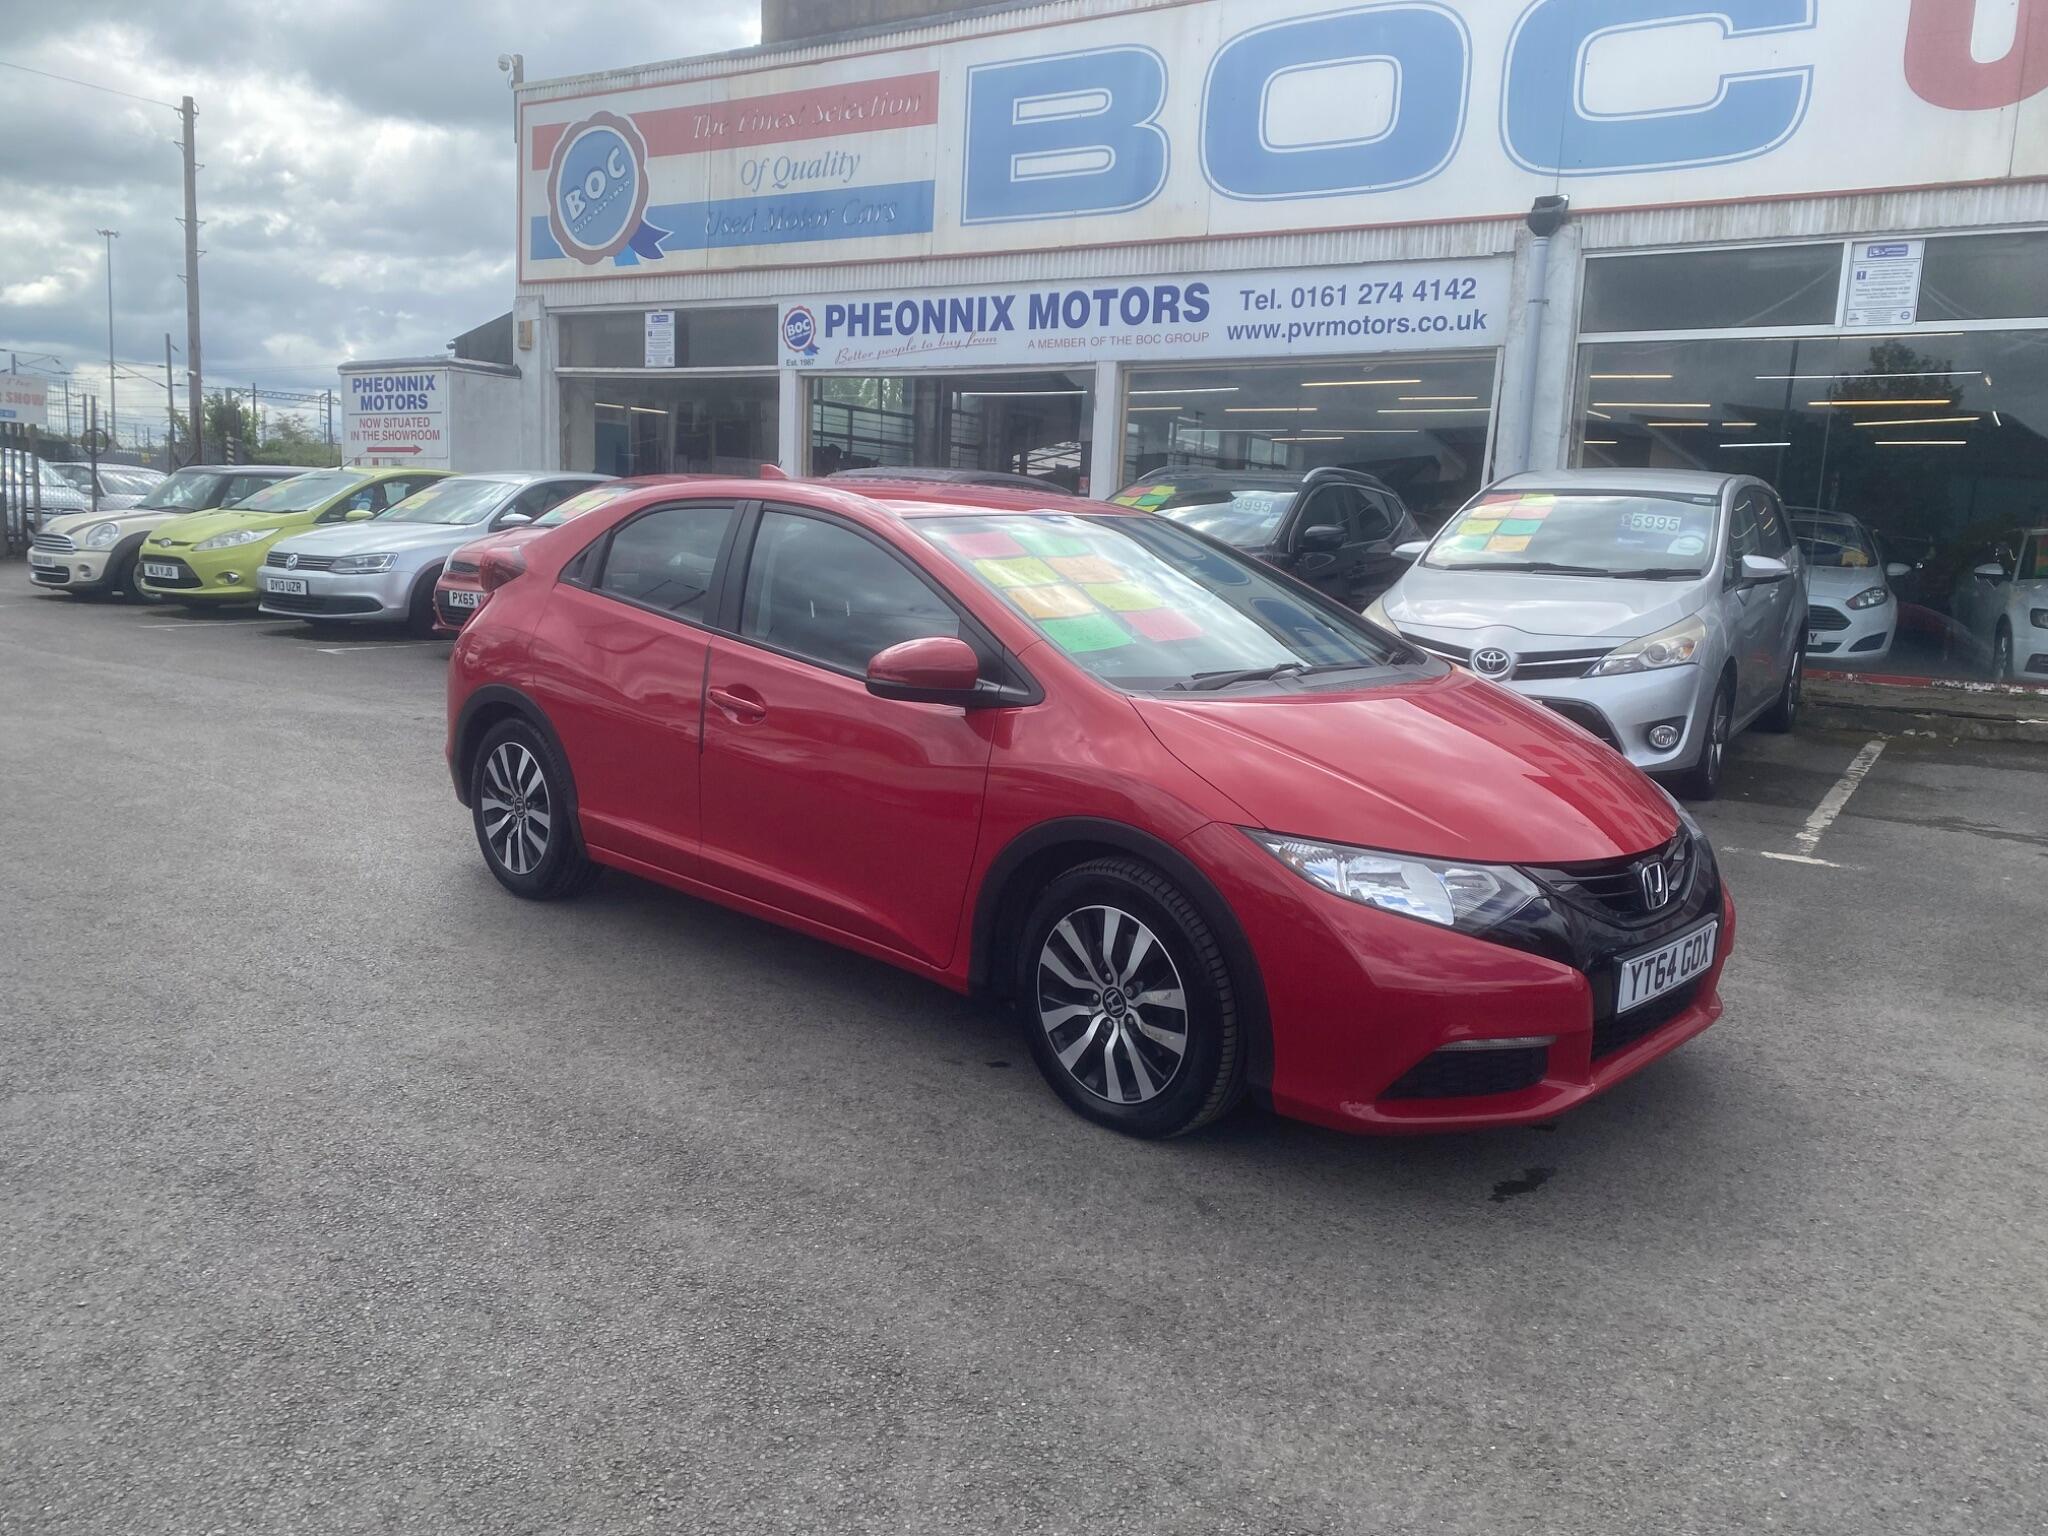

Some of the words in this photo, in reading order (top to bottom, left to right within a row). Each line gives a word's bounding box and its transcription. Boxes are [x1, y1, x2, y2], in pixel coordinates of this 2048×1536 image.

[693, 113, 728, 139] The
[811, 92, 921, 124] Selection
[961, 0, 1816, 225] BOC
[565, 147, 626, 221] BOC
[740, 158, 770, 192] Of
[772, 150, 861, 189] Quality
[705, 208, 758, 237] Used
[762, 205, 835, 233] Motor
[842, 198, 899, 226] Cars
[825, 294, 1016, 338] PHEONNIX
[1029, 282, 1211, 330] MOTORS
[1239, 290, 1282, 311] Tel.
[1291, 284, 1347, 309] 0161
[1357, 281, 1404, 305] 274
[1412, 277, 1477, 302] 4142
[787, 319, 810, 336] BOC
[1028, 339, 1035, 349] A
[1038, 337, 1086, 349] MEMBER
[1090, 336, 1107, 347] OF
[1110, 335, 1131, 346] THE
[1136, 334, 1161, 345] BOC
[1164, 332, 1210, 344] GROUP
[1227, 309, 1487, 343] www.pvrmotors.co.uk
[835, 347, 873, 365] Better
[877, 337, 915, 360] people
[921, 339, 933, 350] to
[938, 334, 961, 348] buy
[965, 330, 997, 348] from
[352, 375, 436, 393] PHEONNIX
[361, 393, 428, 411] MOTORS
[351, 431, 359, 441] IN
[362, 430, 380, 441] THE
[382, 430, 440, 440] SHOWROOM
[359, 417, 381, 428] NOW
[383, 417, 430, 428] SITUATED
[286, 581, 302, 592] UZR
[452, 592, 474, 605] PX65
[1631, 947, 1678, 1001] YT64
